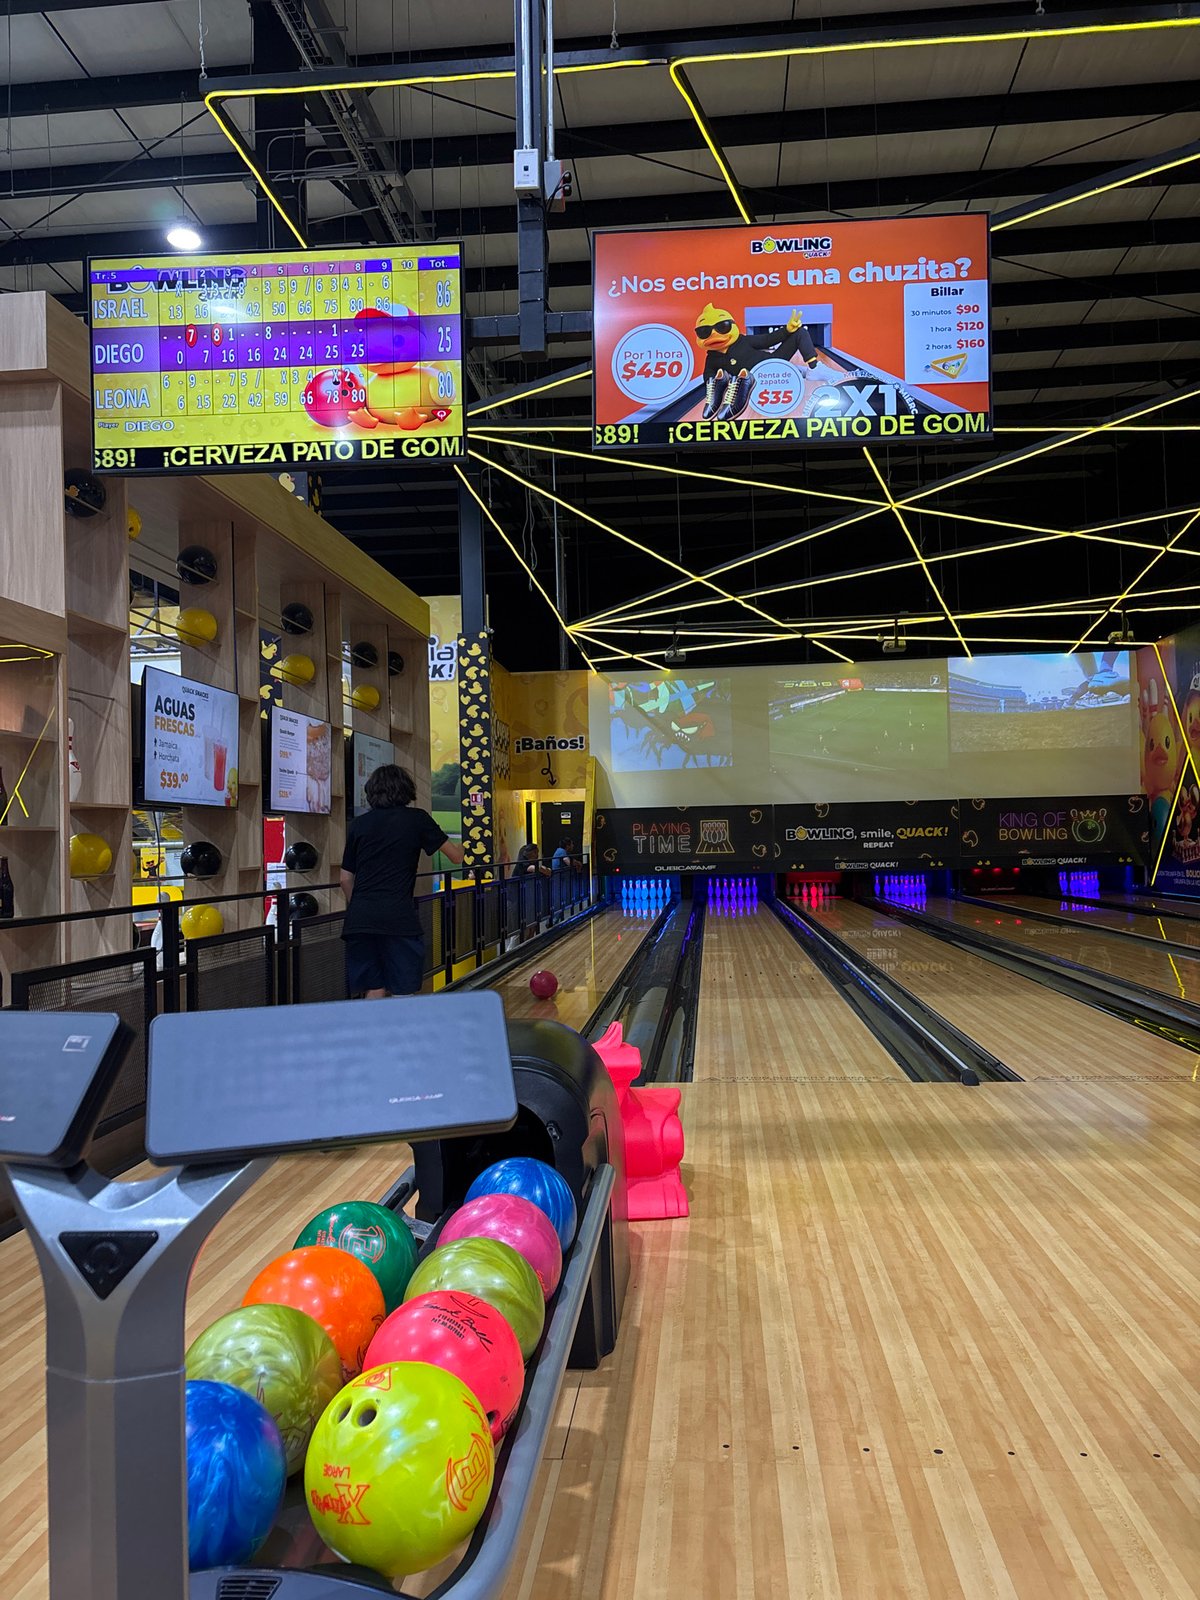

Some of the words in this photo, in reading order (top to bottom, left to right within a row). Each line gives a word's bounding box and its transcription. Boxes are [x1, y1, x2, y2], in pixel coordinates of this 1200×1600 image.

[751, 237, 832, 254] BOWLING
[95, 272, 117, 280] Tr.5
[251, 267, 258, 276] 4
[277, 266, 284, 275] 5
[303, 264, 309, 273] 6
[328, 264, 335, 272] 7
[355, 262, 361, 271] 8
[381, 261, 388, 270] 9
[401, 260, 413, 269] 10
[429, 259, 448, 268] Tot.
[608, 276, 665, 297] ¿Nos
[672, 272, 780, 291] echamos
[787, 267, 841, 286] una
[849, 257, 972, 283] chuzita?
[264, 280, 271, 294] 3
[279, 280, 286, 294] 5
[290, 279, 297, 294] 9
[315, 279, 323, 292] 6
[331, 278, 338, 292] 3
[342, 277, 349, 290] 4
[382, 275, 390, 289] 6
[930, 287, 964, 297] Billar
[169, 305, 183, 319] 13
[195, 303, 209, 318] 16
[246, 303, 260, 316] 42
[272, 301, 286, 315] 50
[297, 300, 312, 315] 66
[324, 299, 338, 313] 75
[350, 298, 364, 312] 80
[375, 297, 390, 311] 86
[436, 280, 451, 307] 86
[94, 298, 148, 319] ISRAEL
[922, 308, 952, 316] minutos
[956, 304, 980, 314] $90
[188, 329, 195, 342] 7
[214, 328, 220, 342] 8
[265, 326, 272, 340] 8
[956, 321, 984, 331] $120
[176, 351, 184, 364] 0
[203, 350, 209, 363] 7
[222, 349, 235, 363] 16
[248, 348, 261, 362] 16
[273, 347, 287, 361] 24
[299, 346, 313, 360] 24
[325, 345, 339, 359] 25
[351, 343, 365, 358] 25
[438, 326, 452, 353] 25
[956, 339, 985, 349] $160
[95, 343, 144, 364] DIEGO
[624, 351, 643, 360] Por
[655, 349, 683, 359] hora
[162, 375, 170, 389] 6
[188, 374, 196, 388] 9
[229, 372, 236, 386] 7
[241, 372, 248, 386] 5
[292, 370, 299, 384] 3
[306, 369, 313, 383] 4
[344, 368, 351, 382] 2
[622, 360, 683, 381] $450
[95, 388, 150, 409] LEONA
[178, 396, 185, 410] 6
[197, 395, 211, 409] 15
[223, 394, 237, 408] 22
[248, 393, 262, 407] 42
[274, 393, 288, 406] 59
[300, 391, 313, 405] 66
[326, 390, 339, 404] 78
[351, 389, 365, 403] 80
[438, 371, 452, 398] 80
[757, 389, 793, 407] $35
[98, 422, 119, 430] Player
[125, 420, 175, 432] DIEGO
[668, 419, 799, 444] ¡CERVEZA
[806, 417, 872, 438] PATO
[880, 415, 915, 435] DE
[923, 413, 989, 433] GOM
[163, 443, 287, 467] ¡CERVEZA
[293, 441, 354, 461] PATO
[361, 439, 395, 459] DE
[401, 437, 464, 458] GOM
[429, 664, 454, 678] K!
[182, 686, 194, 695] QUACK
[195, 689, 209, 699] SNACKS
[154, 695, 195, 721] AGUAS
[154, 715, 195, 737] FRESCAS
[158, 739, 178, 750] Jamaica
[515, 736, 585, 754] ¡Baños!
[158, 753, 180, 763] Horchata
[999, 812, 1038, 828] KING
[1043, 811, 1067, 827] OF
[632, 822, 691, 835] PLAYING
[860, 828, 895, 839] smile,
[896, 826, 949, 839] QUACK!
[999, 828, 1068, 840] BOWLING
[633, 835, 691, 854] TIME
[869, 861, 899, 869] QUACK!
[323, 1464, 350, 1479] LARGE
